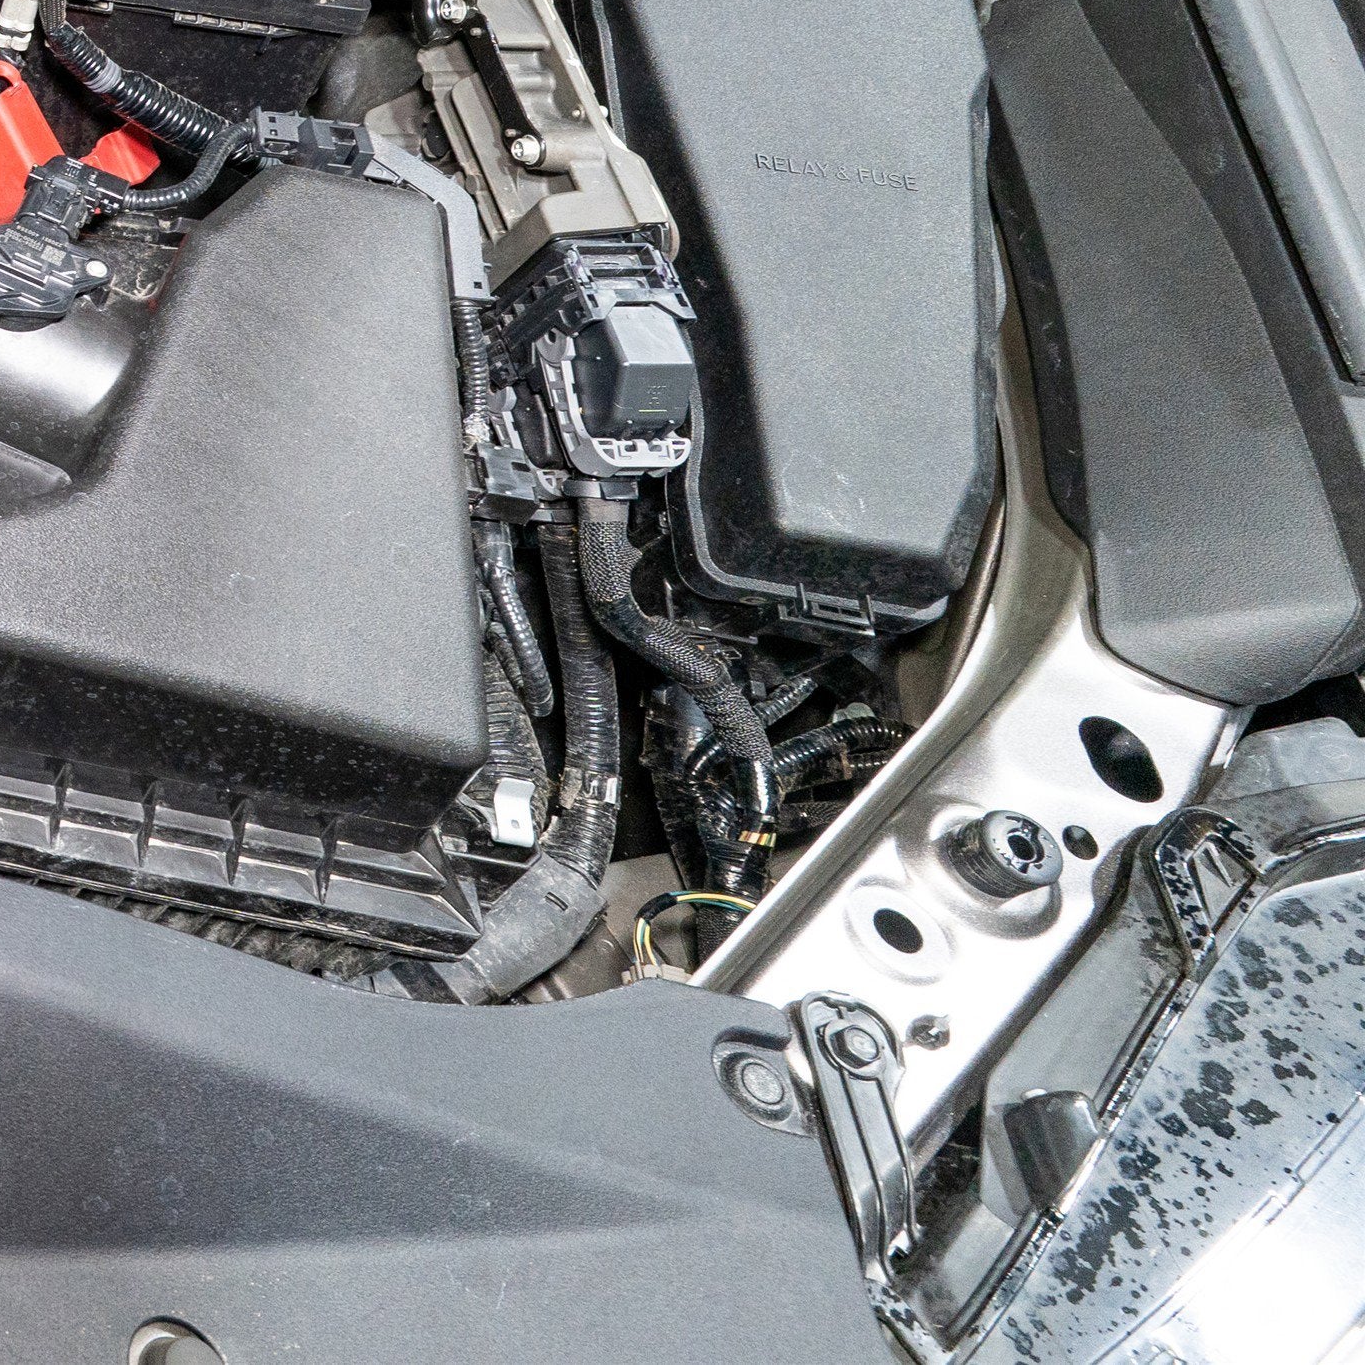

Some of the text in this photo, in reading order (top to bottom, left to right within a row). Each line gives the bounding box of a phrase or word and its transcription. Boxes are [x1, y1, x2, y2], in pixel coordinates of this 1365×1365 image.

[755, 153, 919, 192] RELAY & FUSE
